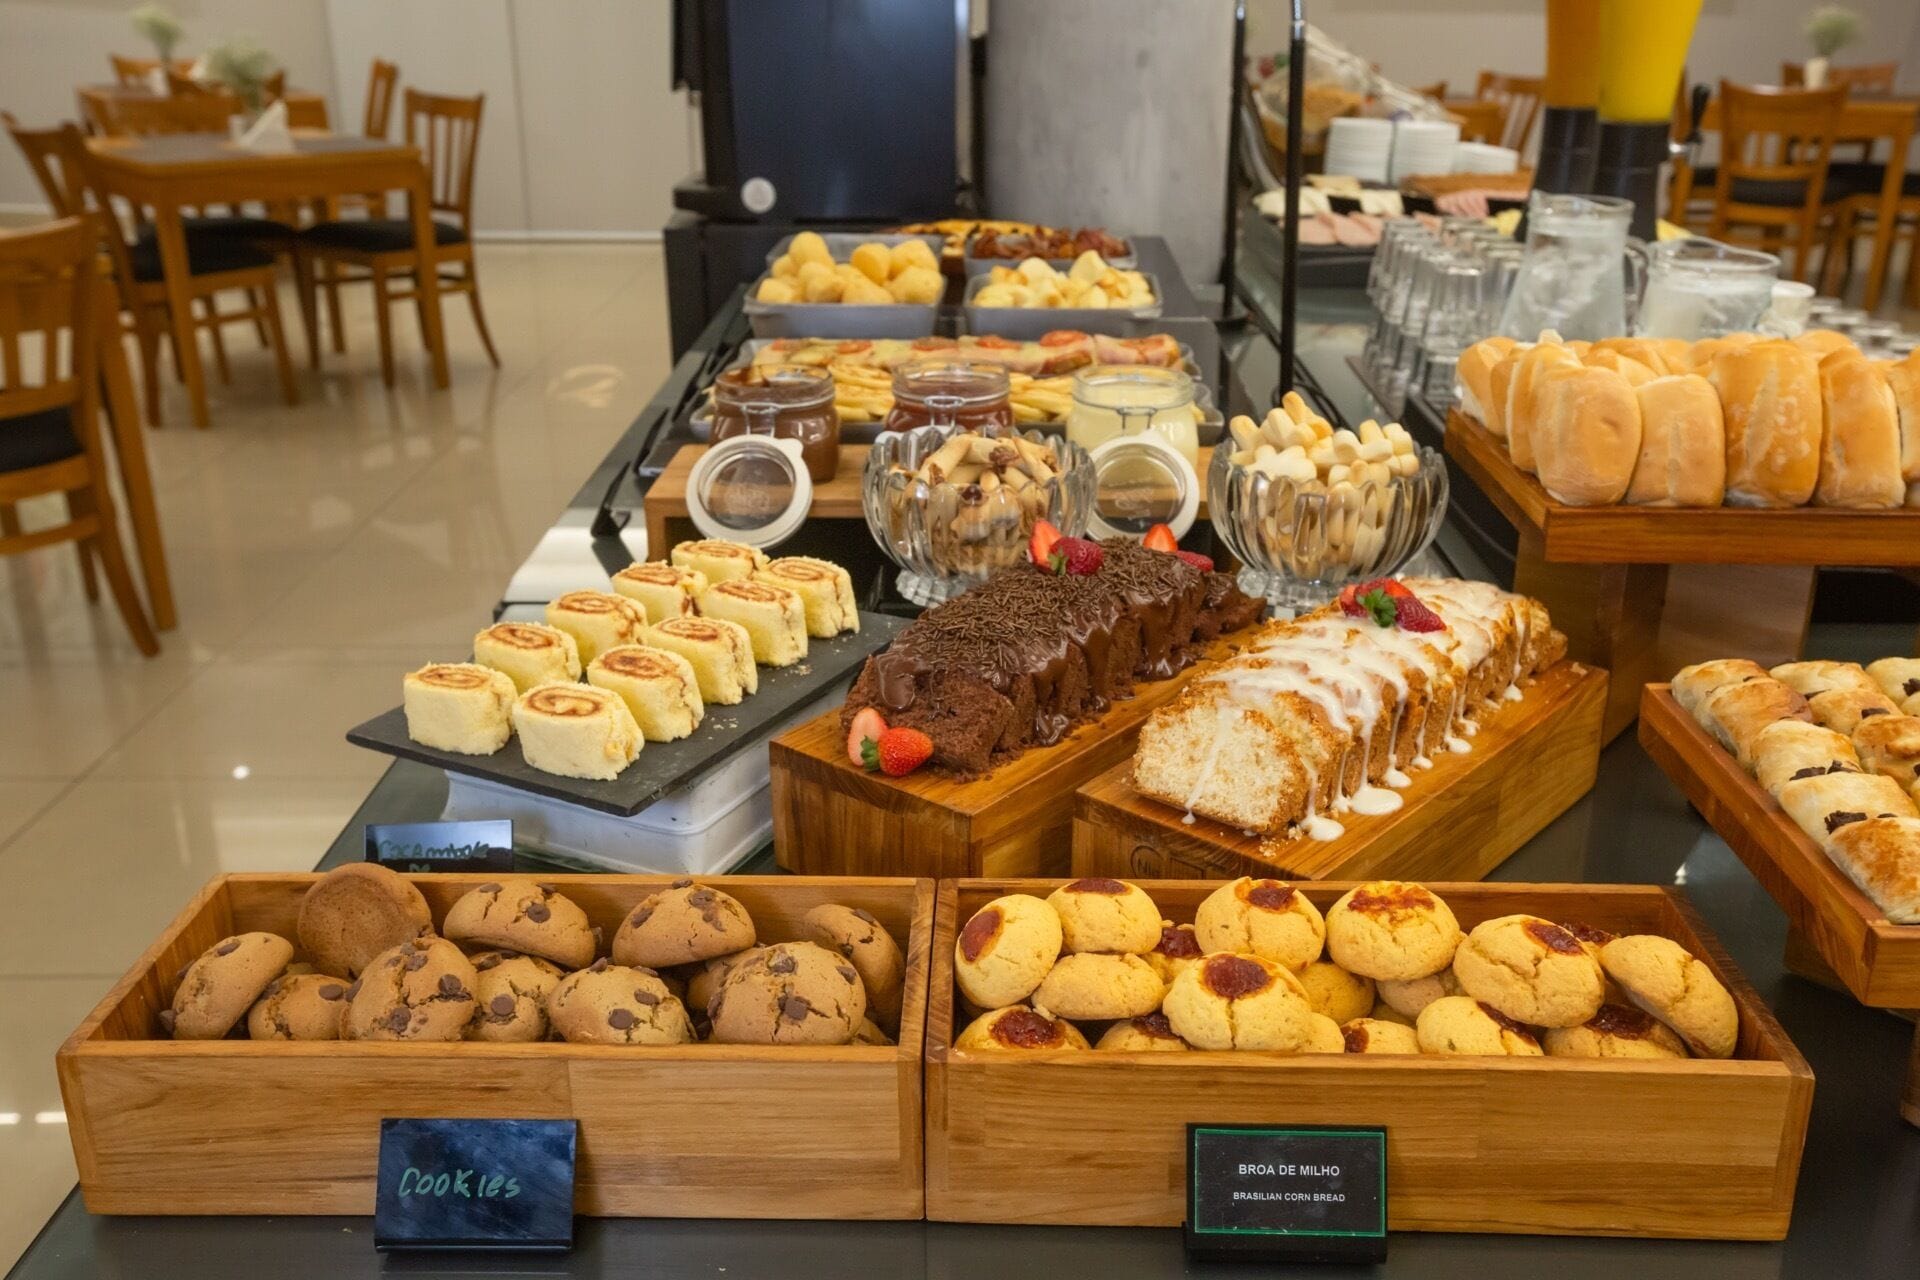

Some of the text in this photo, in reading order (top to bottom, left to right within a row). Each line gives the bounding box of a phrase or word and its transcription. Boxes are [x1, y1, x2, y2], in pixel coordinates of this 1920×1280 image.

[1238, 1164, 1340, 1177] BROA DE MILHO
[1233, 1191, 1345, 1202] BRASILIAN CORN BREAD
